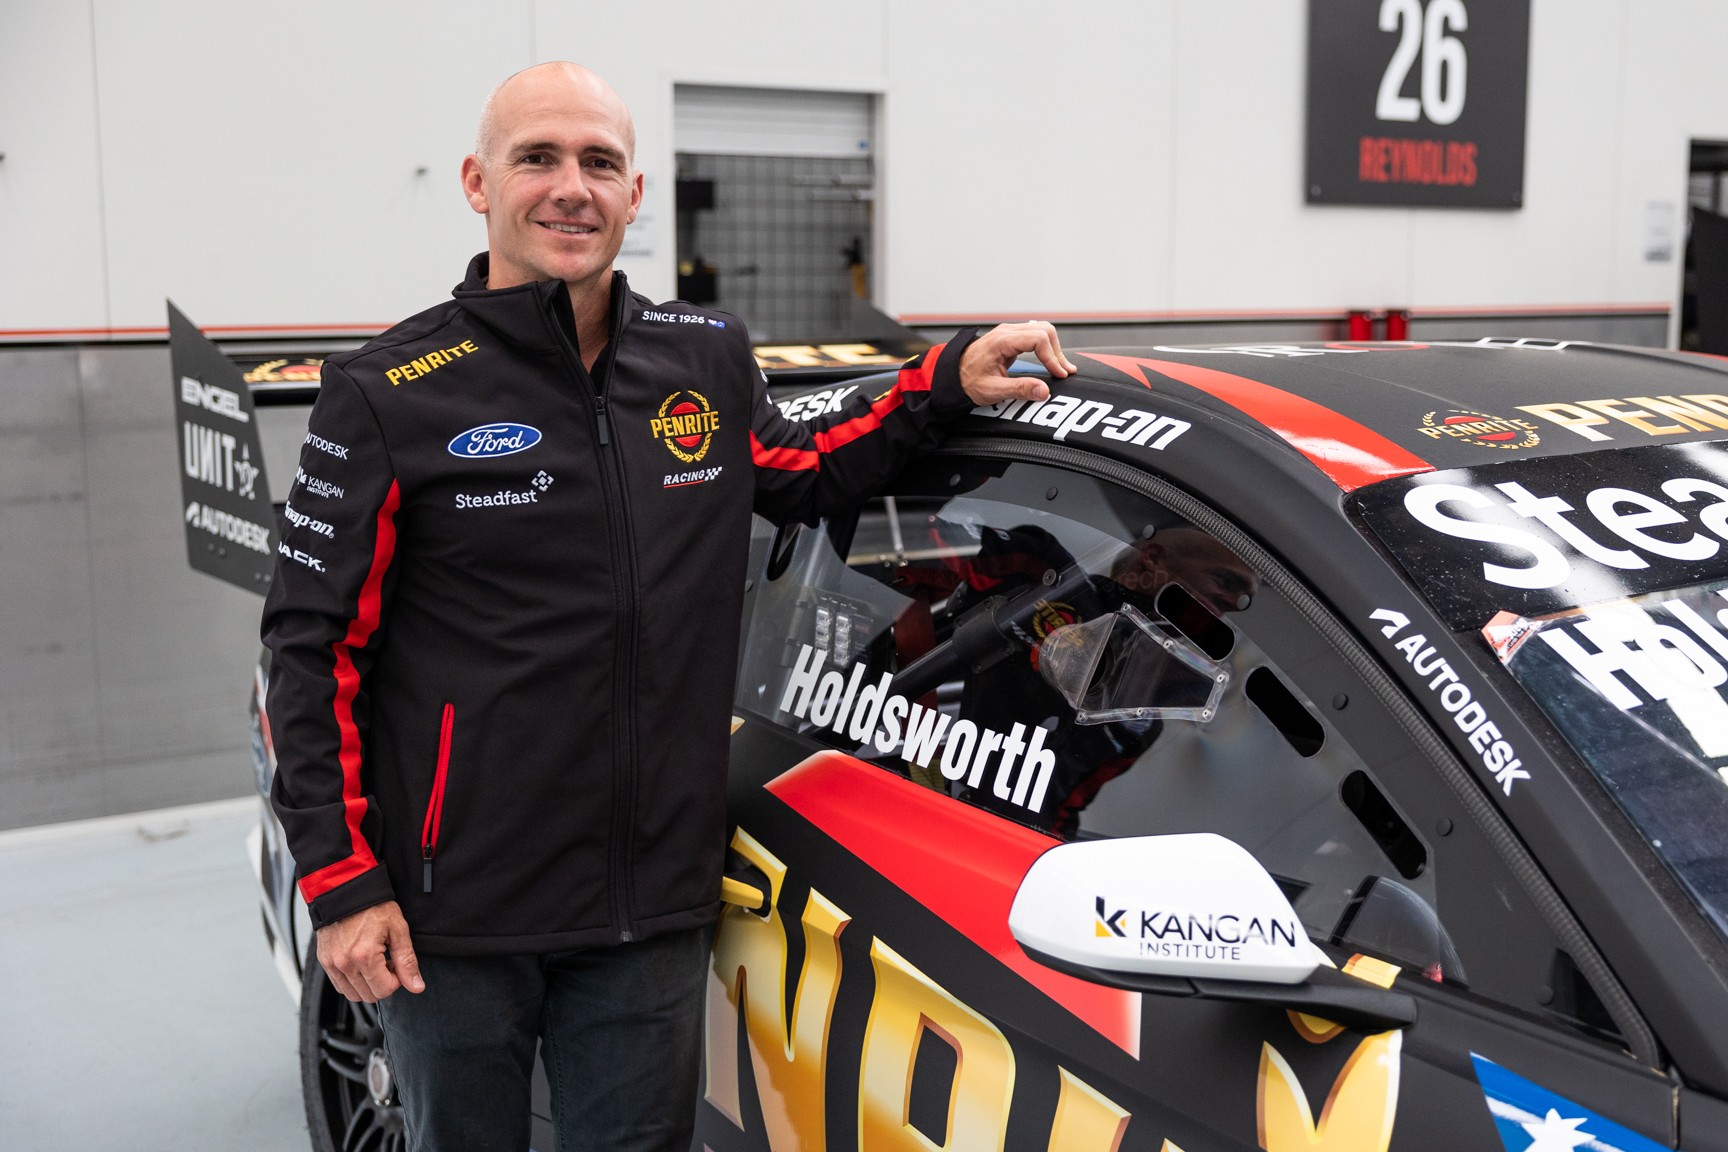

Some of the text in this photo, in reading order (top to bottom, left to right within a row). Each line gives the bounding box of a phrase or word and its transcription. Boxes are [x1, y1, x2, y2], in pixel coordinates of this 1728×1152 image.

[1376, 0, 1468, 124] 26
[1358, 136, 1478, 186] REYNOLDS
[642, 311, 705, 325] SINCE 1926
[385, 339, 479, 386] PENRITE
[650, 411, 720, 438] PENRITE
[1416, 418, 1540, 440] PENRITE
[467, 428, 525, 454] Ford
[308, 476, 344, 499] KANGAN
[664, 469, 705, 486] RACING
[455, 489, 538, 509] Steadfast
[200, 503, 271, 557] AUTODESK
[1537, 588, 1728, 712] Hol
[780, 644, 1056, 814] Holdsworth
[1394, 634, 1531, 796] AUTODESK
[1140, 911, 1296, 947] KANGAN
[1139, 942, 1241, 960] INSTITUTE
